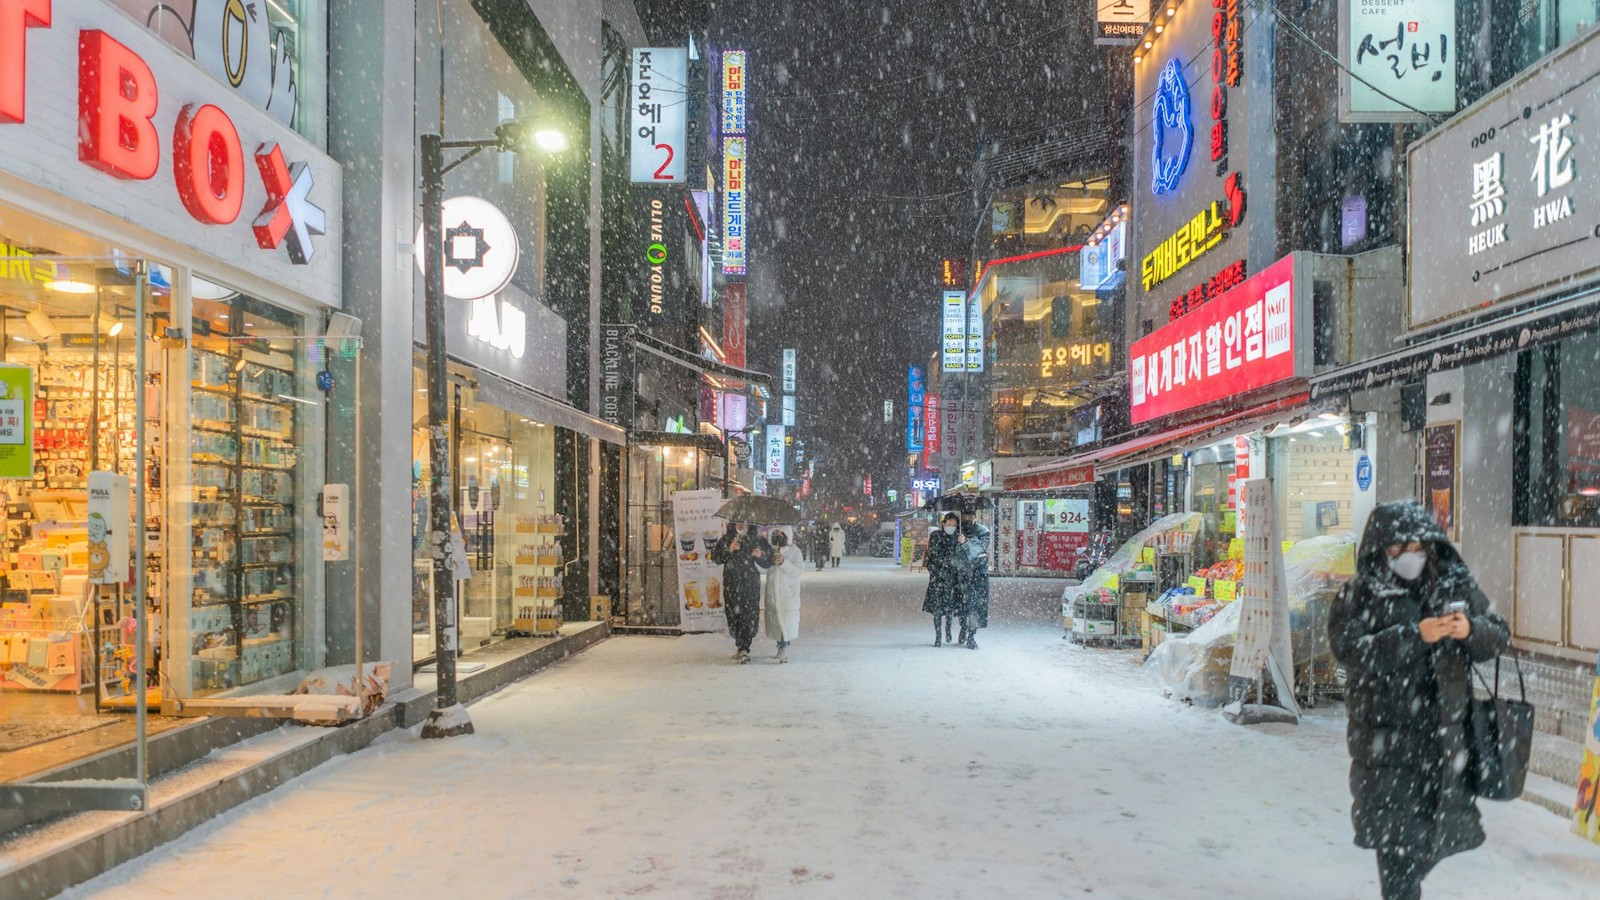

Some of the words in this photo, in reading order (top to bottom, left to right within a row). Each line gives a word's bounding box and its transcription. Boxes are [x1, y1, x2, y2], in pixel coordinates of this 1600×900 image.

[1103, 24, 1144, 35] 성신여대점
[638, 51, 662, 146] 준오헤어
[652, 143, 675, 180] 2
[728, 158, 742, 191] 미니미
[650, 198, 663, 243] OLIVE
[727, 191, 742, 237] 보드게임
[1533, 195, 1573, 230] HWA
[1468, 223, 1506, 256] HEUK
[650, 264, 664, 316] YOUNG
[605, 328, 619, 391] BLACKLINE
[1041, 342, 1111, 378] 준오헤어
[1146, 298, 1264, 397] 세계과자할인점
[946, 402, 957, 457] 코인노래방
[90, 488, 110, 496] PULL
[1060, 511, 1090, 524] 924-
